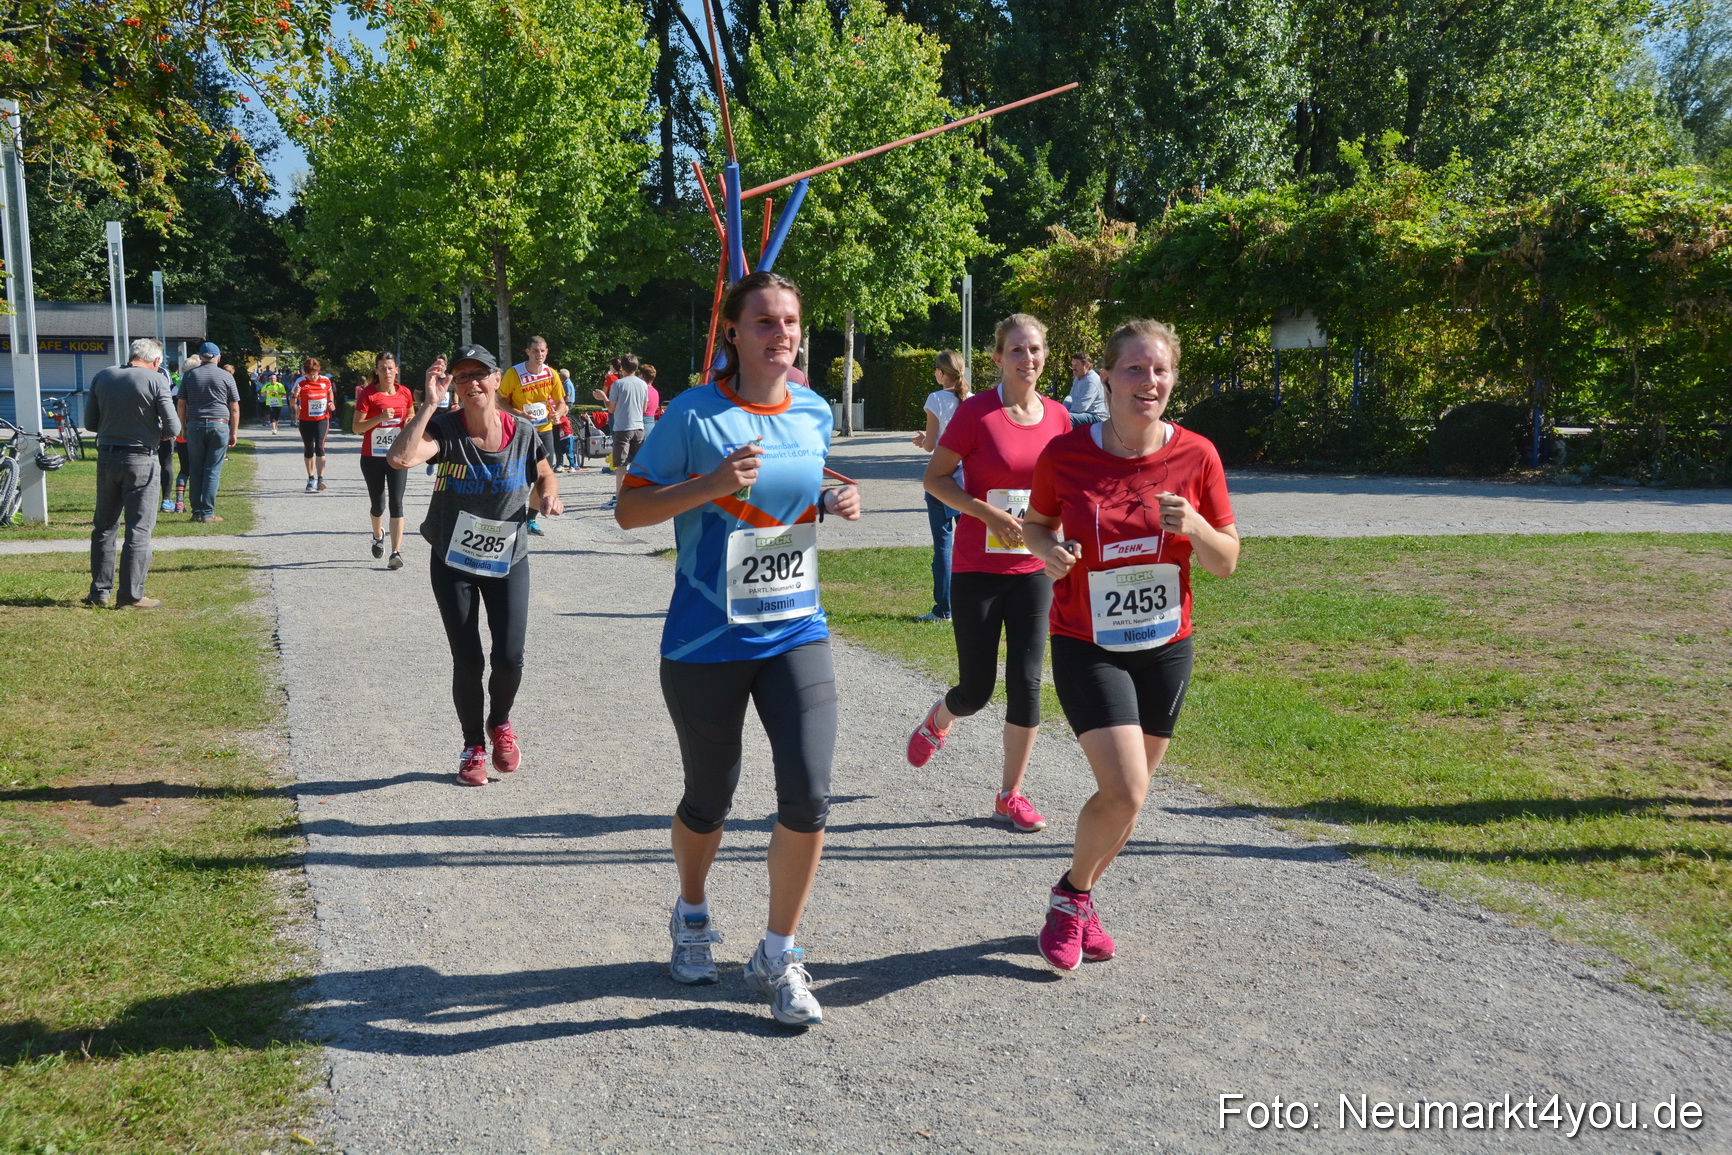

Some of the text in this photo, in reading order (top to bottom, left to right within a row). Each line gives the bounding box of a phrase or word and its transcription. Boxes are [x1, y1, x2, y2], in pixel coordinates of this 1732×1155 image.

[69, 342, 105, 351] KIOSK
[461, 530, 506, 553] 2285
[756, 534, 793, 547] BOCK
[1118, 543, 1143, 554] DEHN
[464, 557, 492, 570] Claudia
[742, 550, 804, 584] 2302
[1116, 570, 1154, 584] BOCK
[757, 597, 795, 612] Jasmin
[1105, 584, 1168, 617] 2453
[1124, 628, 1156, 642] Nicole
